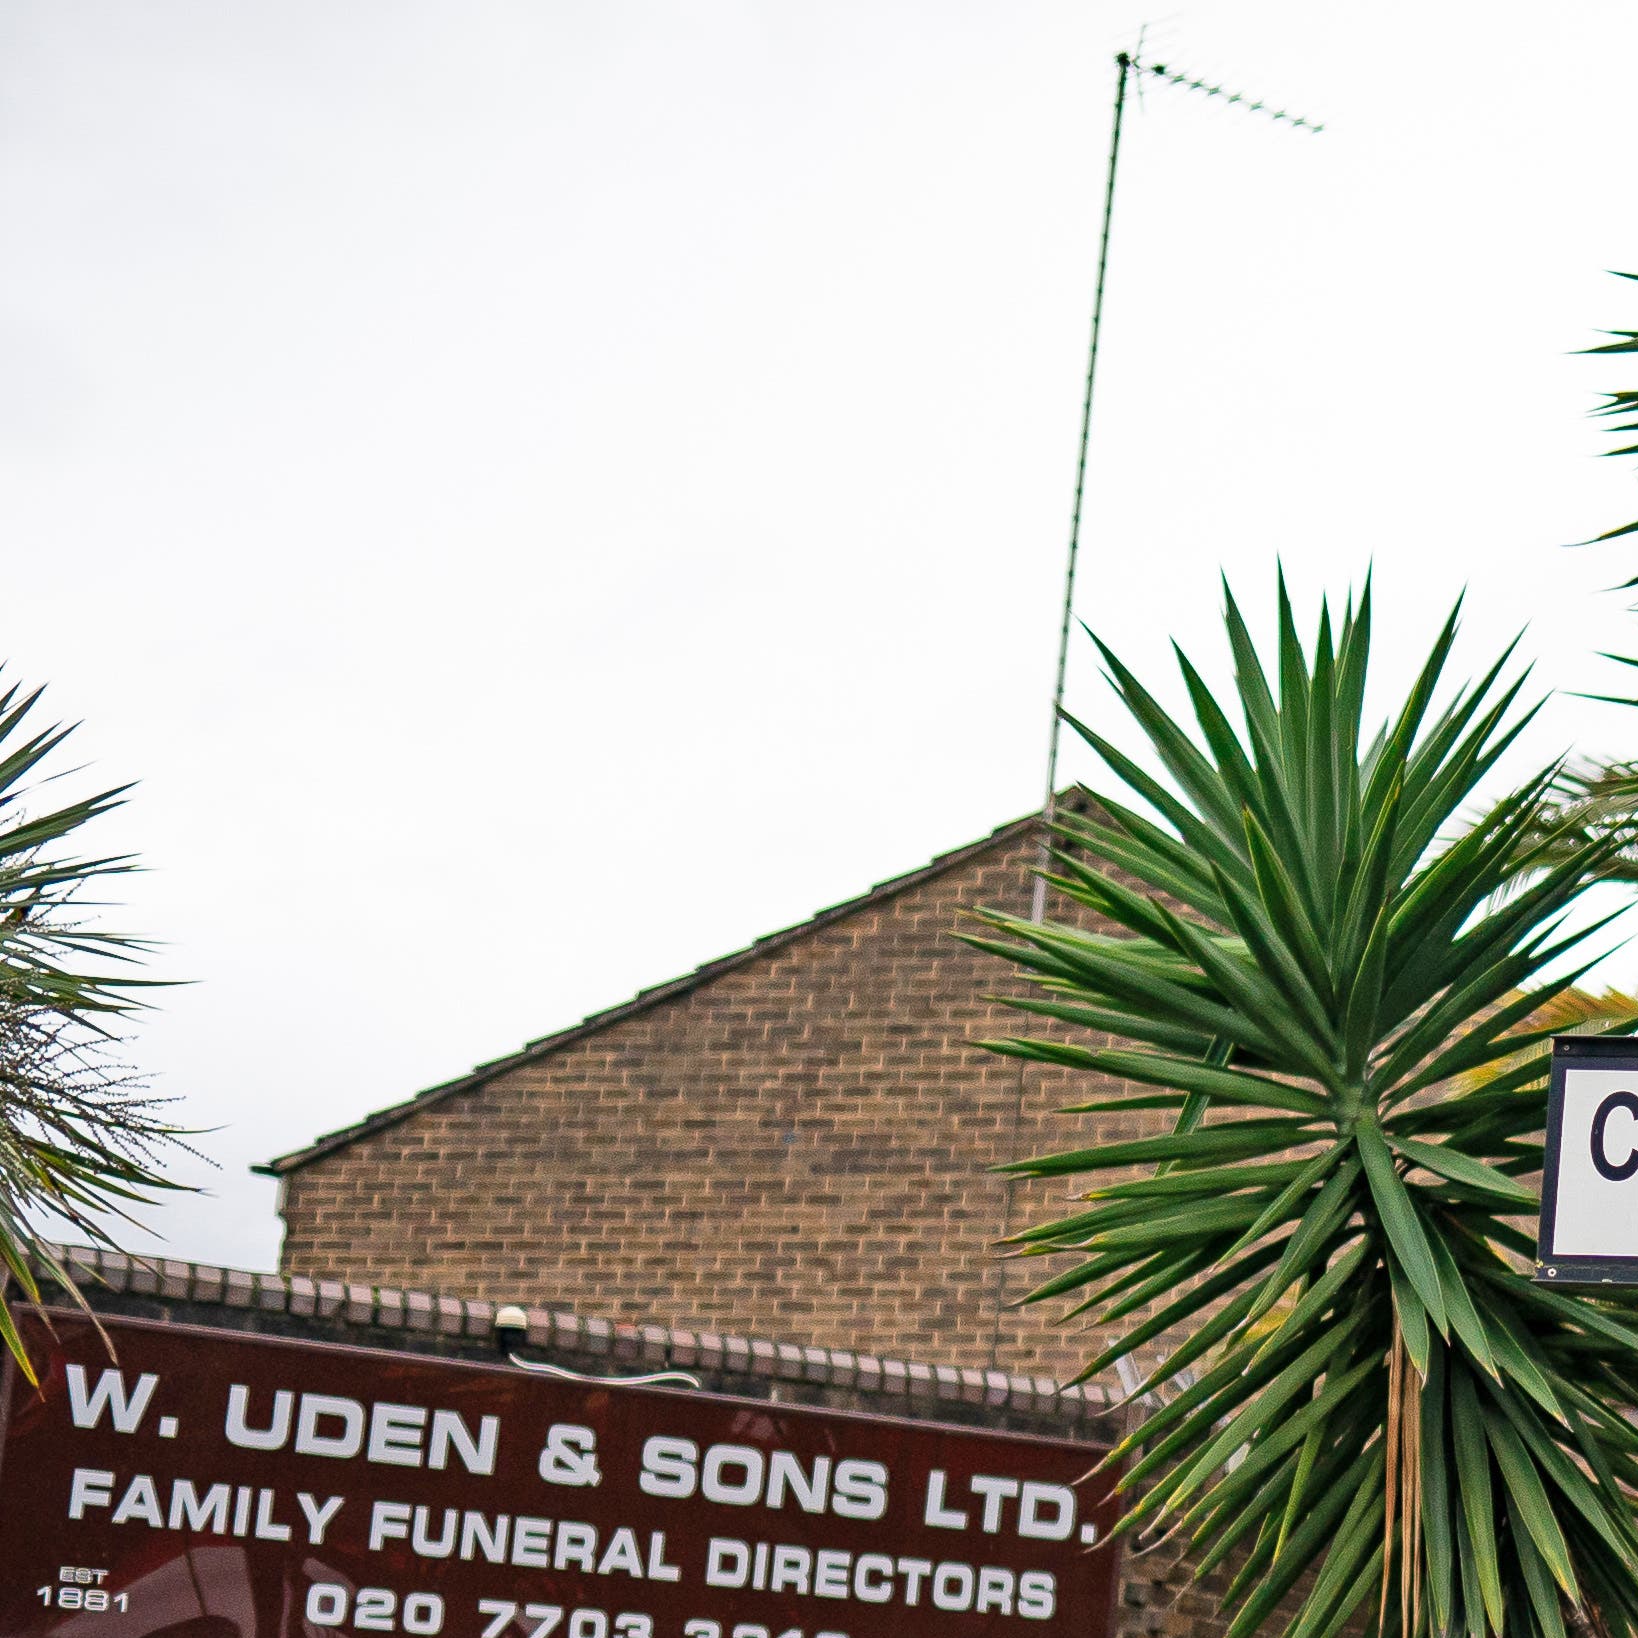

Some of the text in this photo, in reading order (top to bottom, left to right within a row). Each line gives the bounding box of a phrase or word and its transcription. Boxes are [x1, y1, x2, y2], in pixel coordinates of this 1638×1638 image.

[65, 1362, 1097, 1545] W. UDEN & SONS LTD.
[68, 1467, 1057, 1620] FAMILY FUNERAL DIRECTORS
[36, 1585, 130, 1614] 1881
[58, 1566, 110, 1586] EST
[305, 1581, 444, 1635] 020
